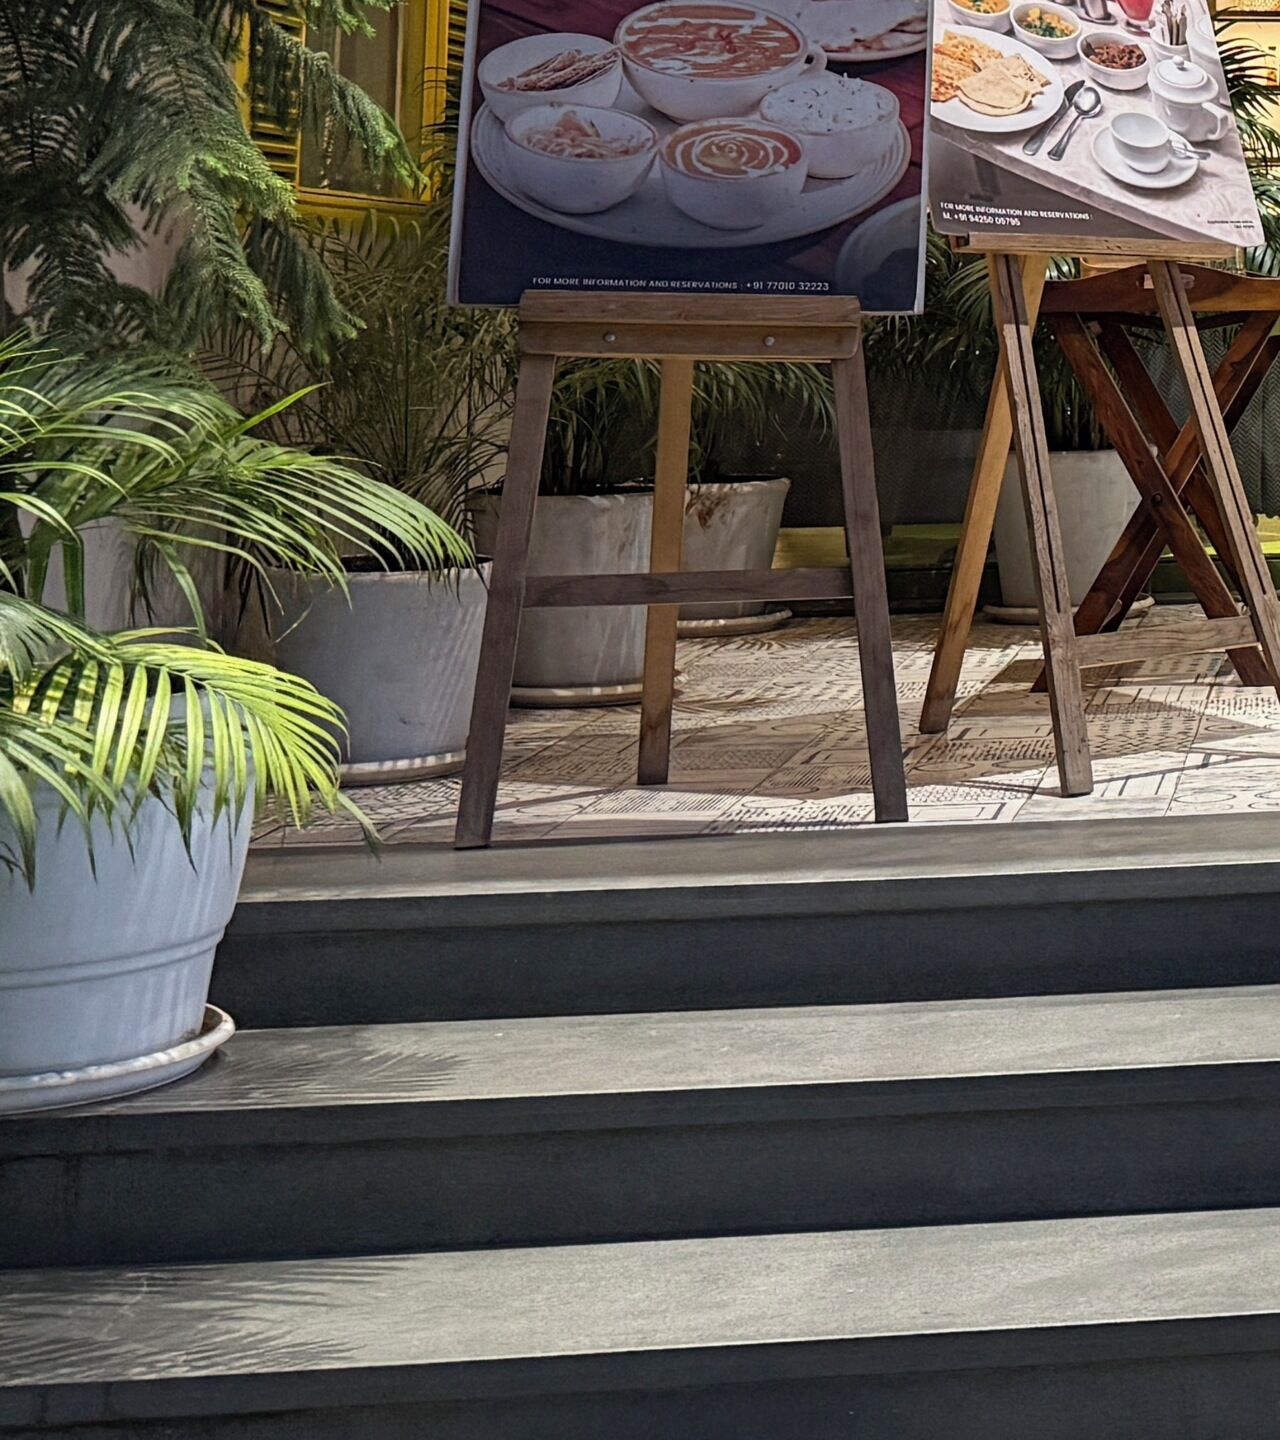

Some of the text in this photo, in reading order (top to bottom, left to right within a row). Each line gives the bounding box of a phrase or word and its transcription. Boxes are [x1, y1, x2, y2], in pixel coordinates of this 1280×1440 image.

[955, 203, 974, 212] MORE
[975, 205, 1023, 217] INFORMATION
[1024, 209, 1039, 217] AND
[532, 276, 551, 285] FOR
[553, 277, 580, 286] MORE
[582, 278, 647, 288] INFORMATION
[648, 279, 669, 288] AND
[766, 281, 795, 290] 77010
[798, 281, 830, 291] 32223
